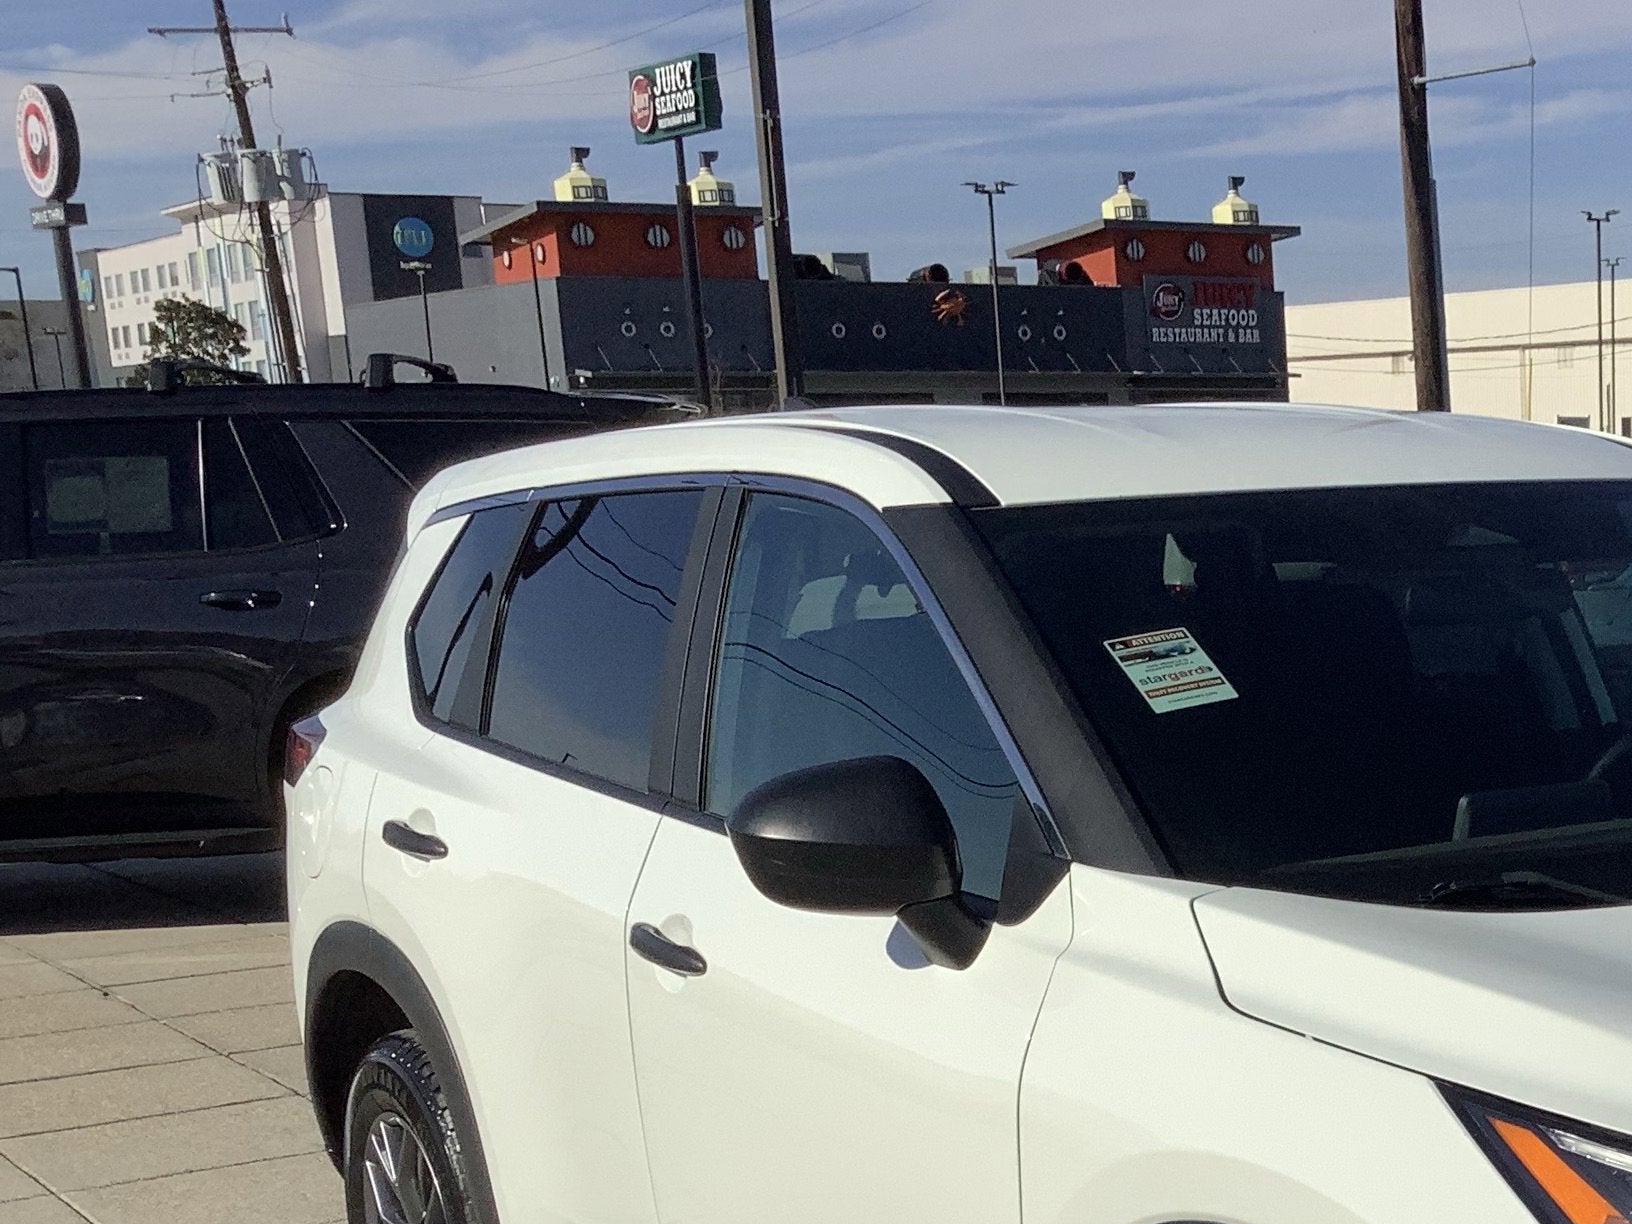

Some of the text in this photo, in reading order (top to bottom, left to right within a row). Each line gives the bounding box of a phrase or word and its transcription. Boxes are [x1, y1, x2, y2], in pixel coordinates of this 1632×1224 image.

[653, 60, 693, 96] JUICY
[655, 89, 696, 116] SEAFOOD
[1193, 308, 1258, 327] SEAFOOD
[1152, 327, 1261, 344] RESTAURANT & BAR
[1131, 630, 1186, 648] ATTENTION
